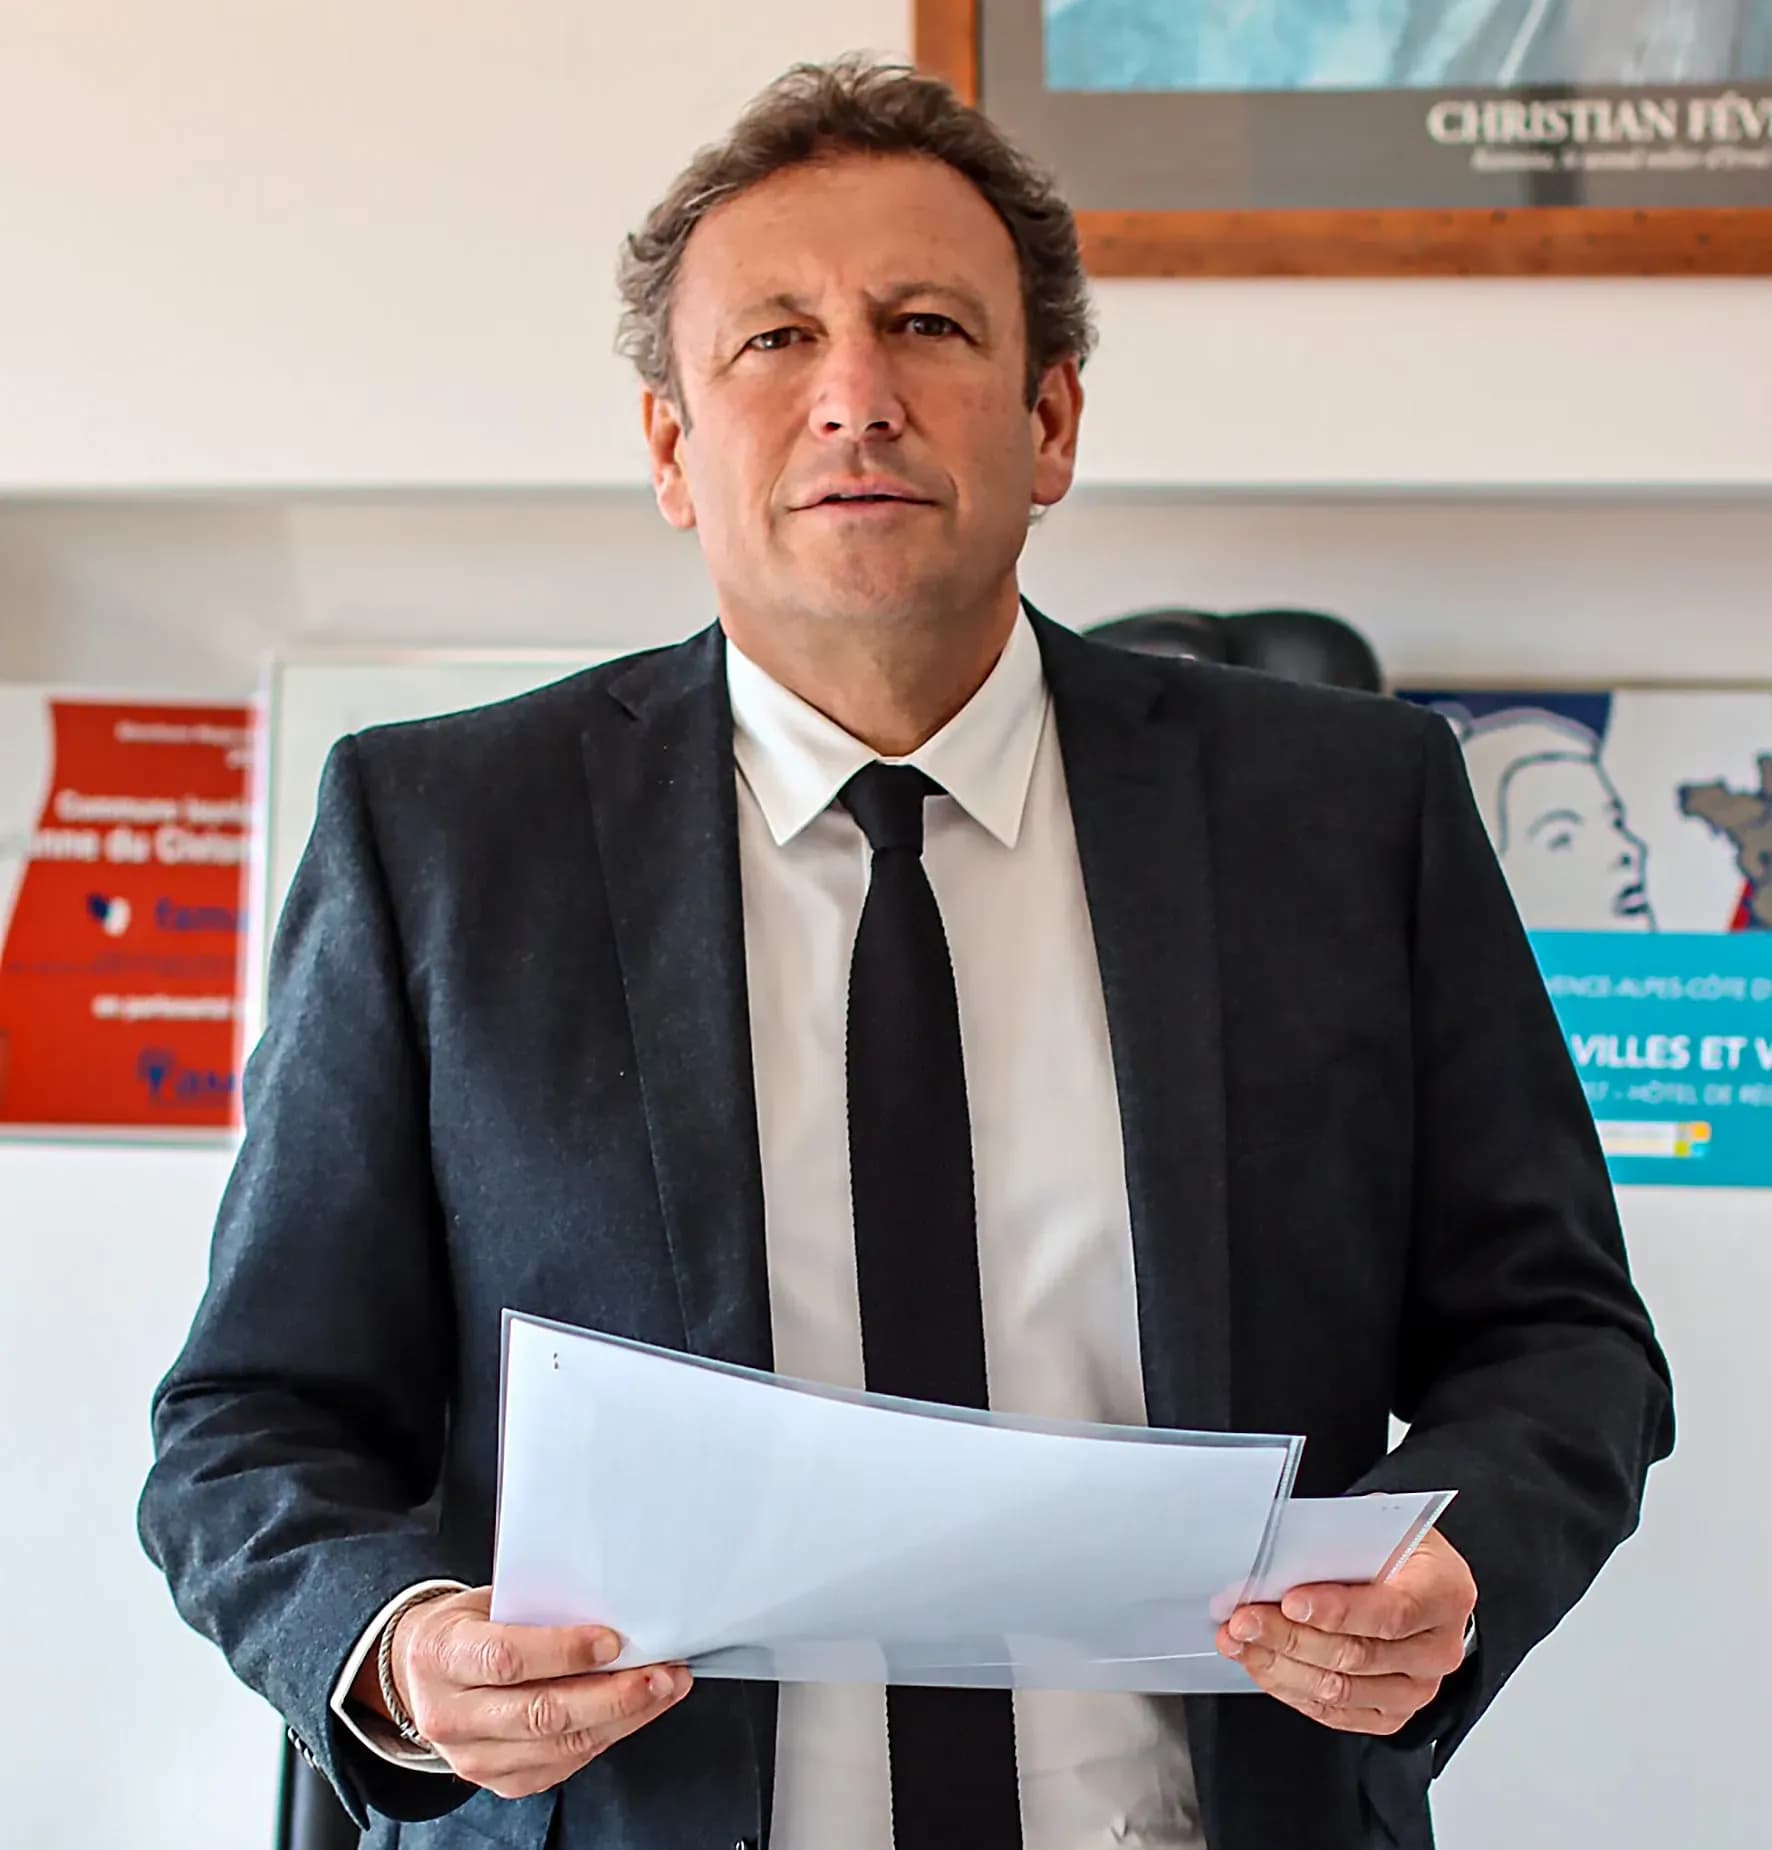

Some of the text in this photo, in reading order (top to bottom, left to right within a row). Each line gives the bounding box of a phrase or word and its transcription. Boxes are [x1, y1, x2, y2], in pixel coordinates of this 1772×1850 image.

[1426, 99, 1678, 143] CHRISTIAN
[55, 790, 178, 823] Commune
[105, 826, 149, 863] du
[1571, 1034, 1691, 1069] VILLES
[1700, 1035, 1748, 1070] ET
[1627, 1080, 1697, 1104] HÔTEL
[1704, 1084, 1732, 1105] DE
